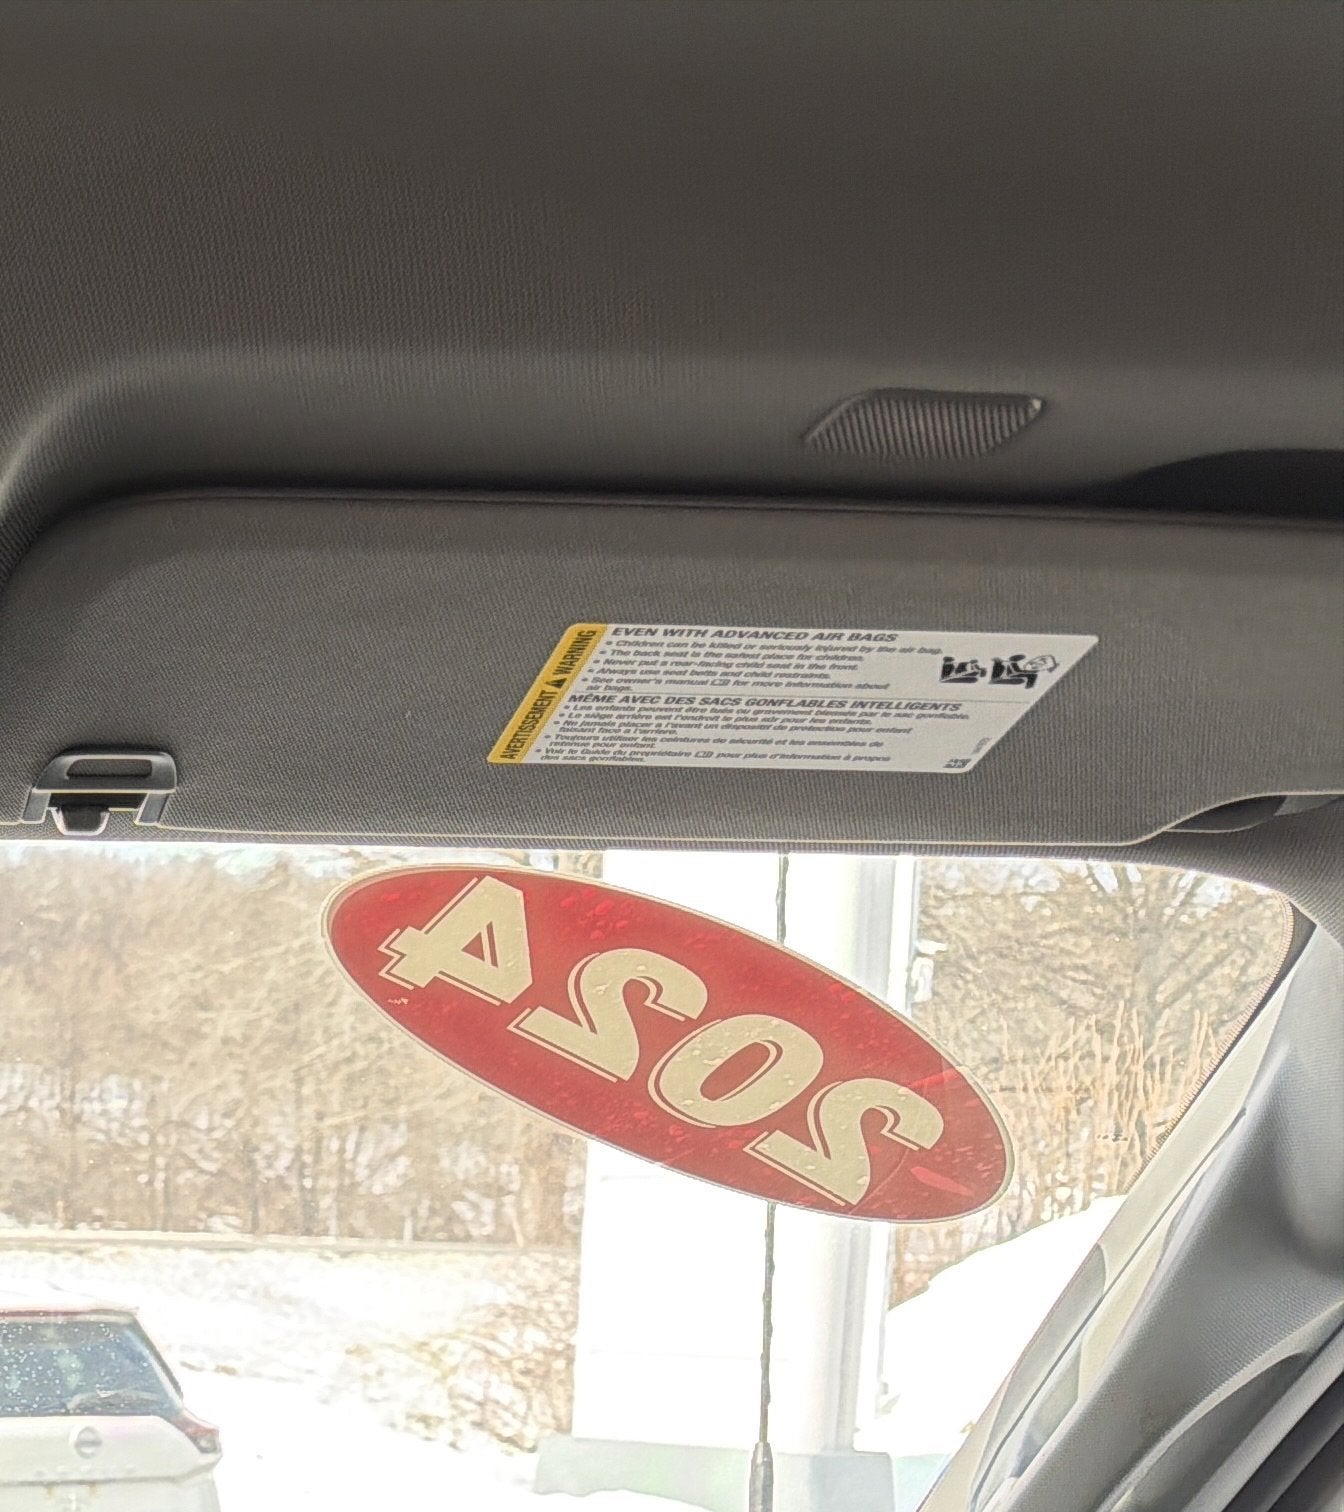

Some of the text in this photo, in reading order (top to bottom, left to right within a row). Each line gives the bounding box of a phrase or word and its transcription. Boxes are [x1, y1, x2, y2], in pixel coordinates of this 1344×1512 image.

[609, 626, 900, 642] EVEN WITH ADVANCED AIR BAGS
[553, 630, 597, 675] WARNING
[566, 692, 964, 711] MÊME AVEC DES SACS GONFLABLES INTELLIGENTS
[500, 690, 558, 760] AVERTISSEMENT
